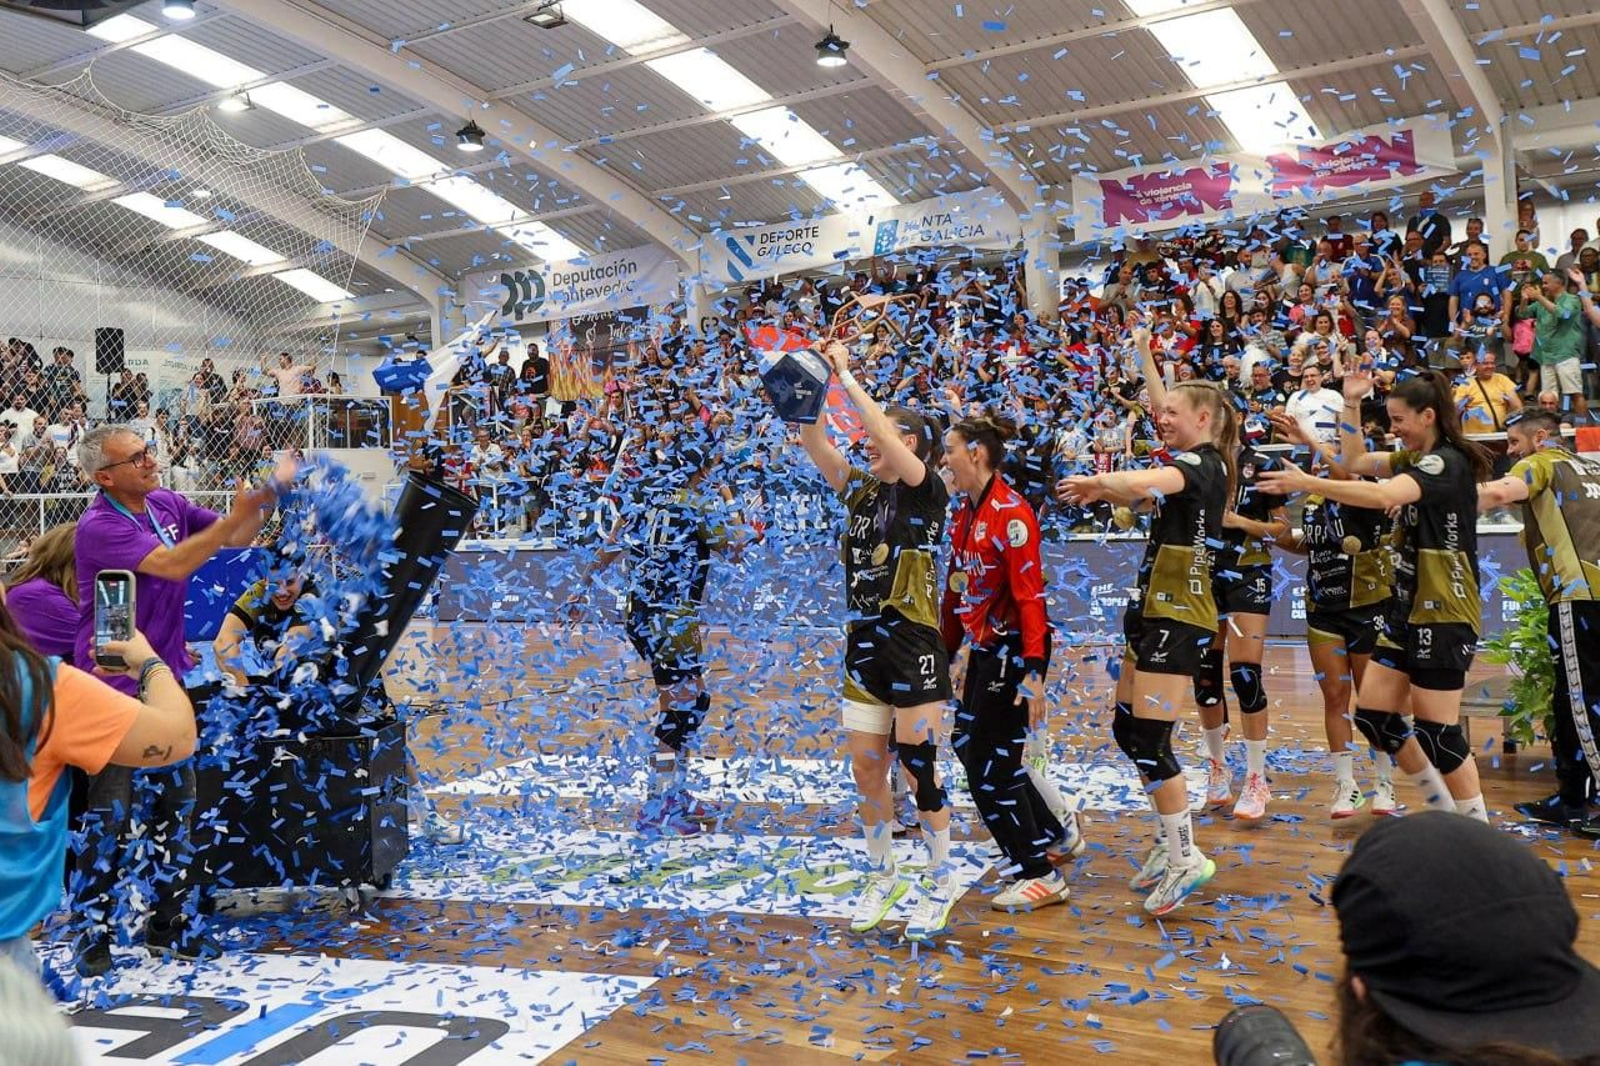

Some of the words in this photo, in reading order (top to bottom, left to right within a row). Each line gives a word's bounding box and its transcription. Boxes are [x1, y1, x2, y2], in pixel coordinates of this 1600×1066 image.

[904, 213, 952, 231] NTA
[760, 226, 820, 244] DEPORTE
[553, 259, 637, 287] Deputación
[1190, 509, 1206, 576] PipeWorks
[1255, 577, 1266, 593] 15
[1292, 610, 1306, 619] CU
[1373, 615, 1386, 631] 38
[1160, 629, 1170, 648] 7
[1417, 628, 1432, 645] 13
[919, 655, 935, 675] 27
